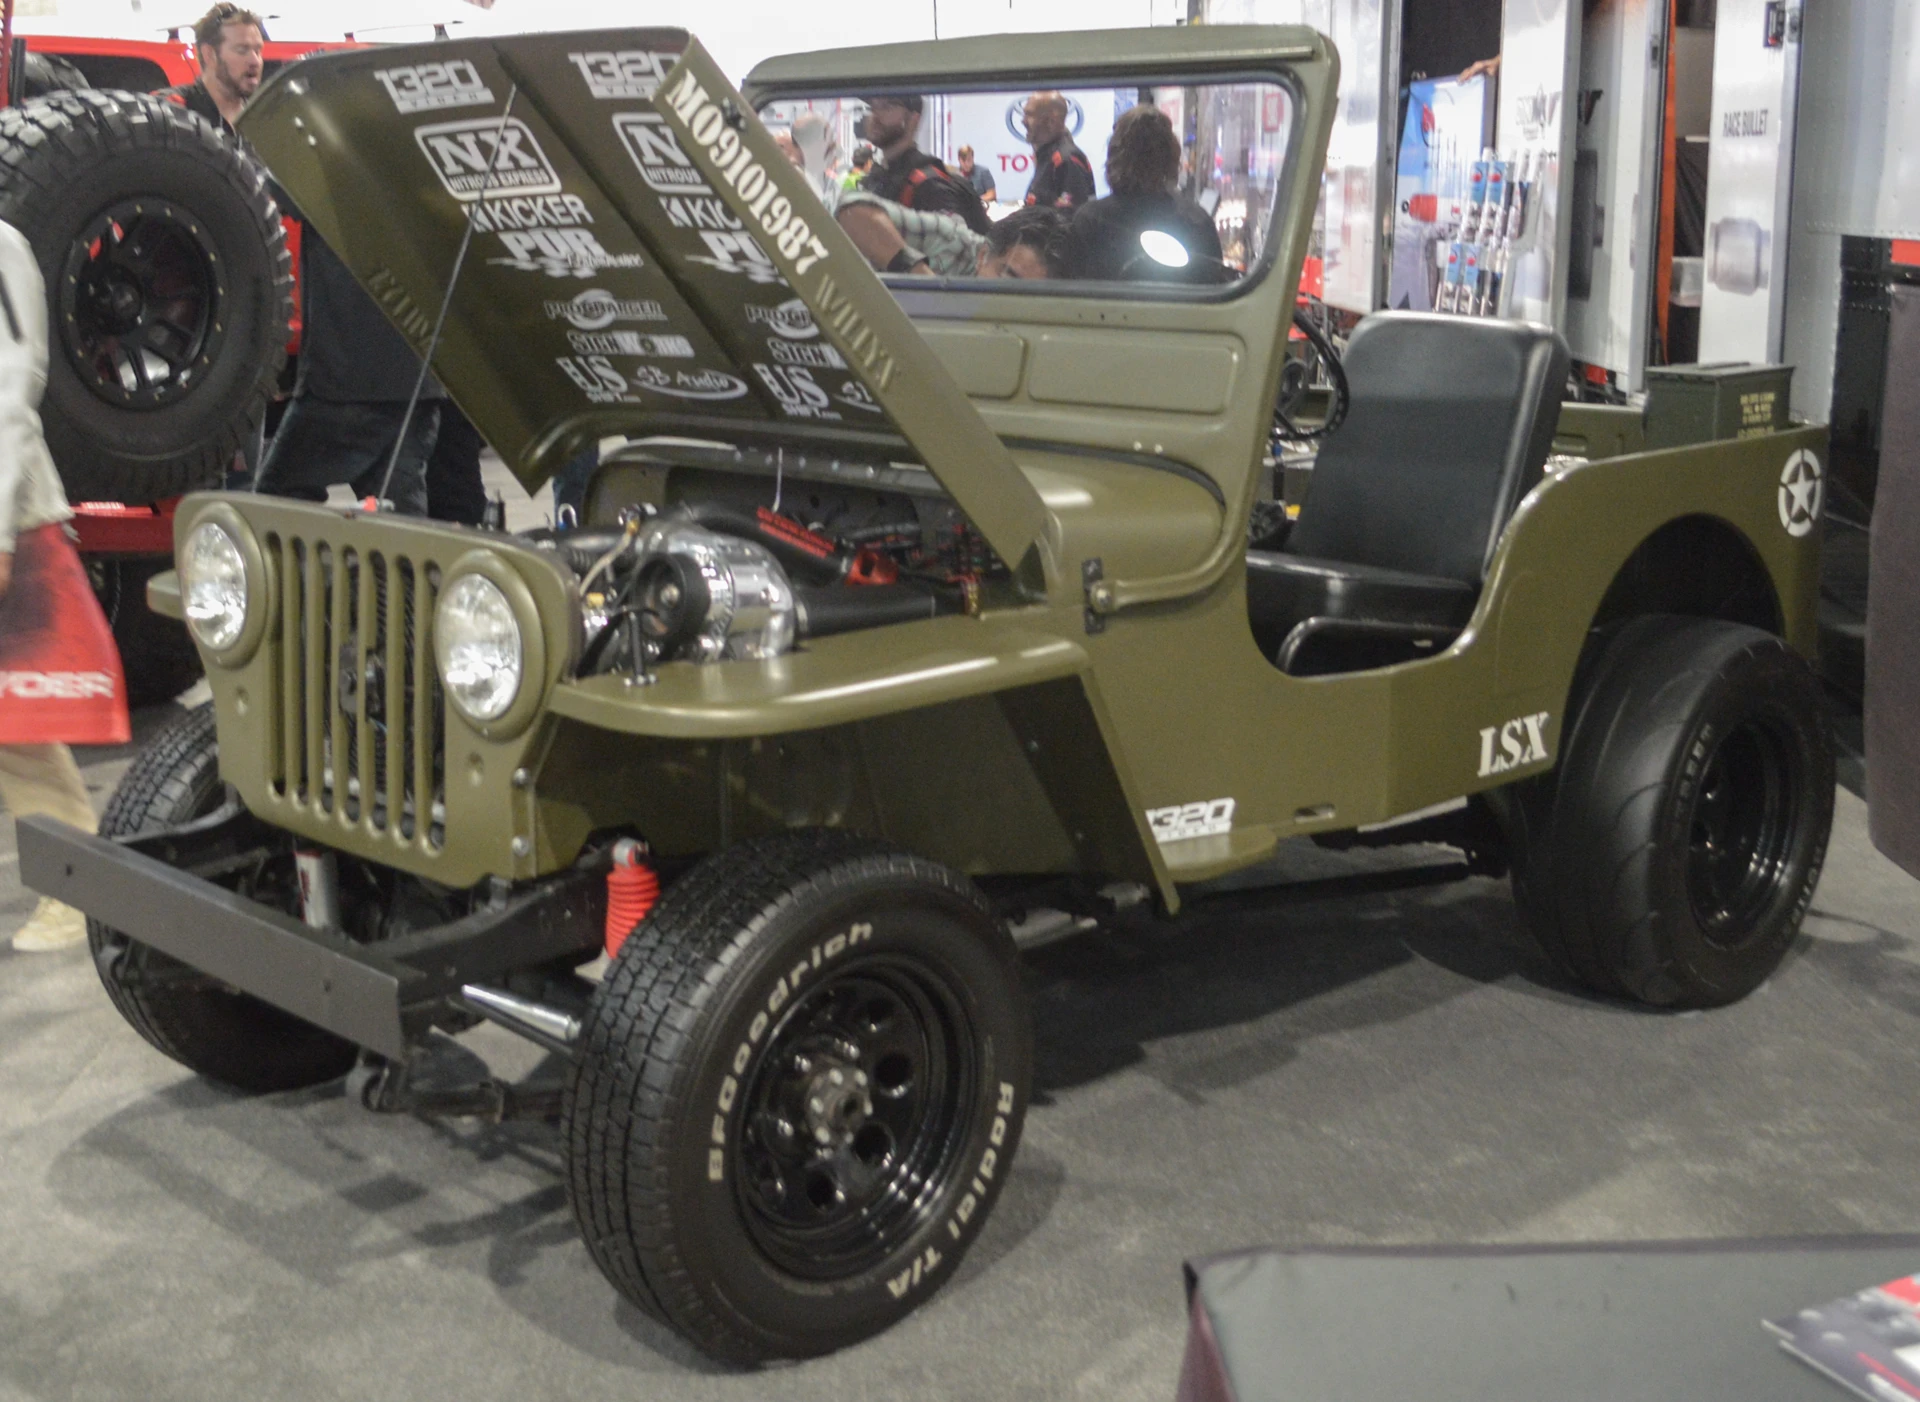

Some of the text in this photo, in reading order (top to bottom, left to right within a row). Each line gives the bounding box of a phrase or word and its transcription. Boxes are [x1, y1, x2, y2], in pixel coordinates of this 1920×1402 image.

[373, 59, 485, 101] 1320
[1723, 111, 1741, 137] RACE
[427, 128, 539, 175] NX
[448, 168, 550, 193] NITROUS EXPRESS
[1477, 711, 1549, 778] LSX
[886, 1081, 1015, 1298] Radial T/A
